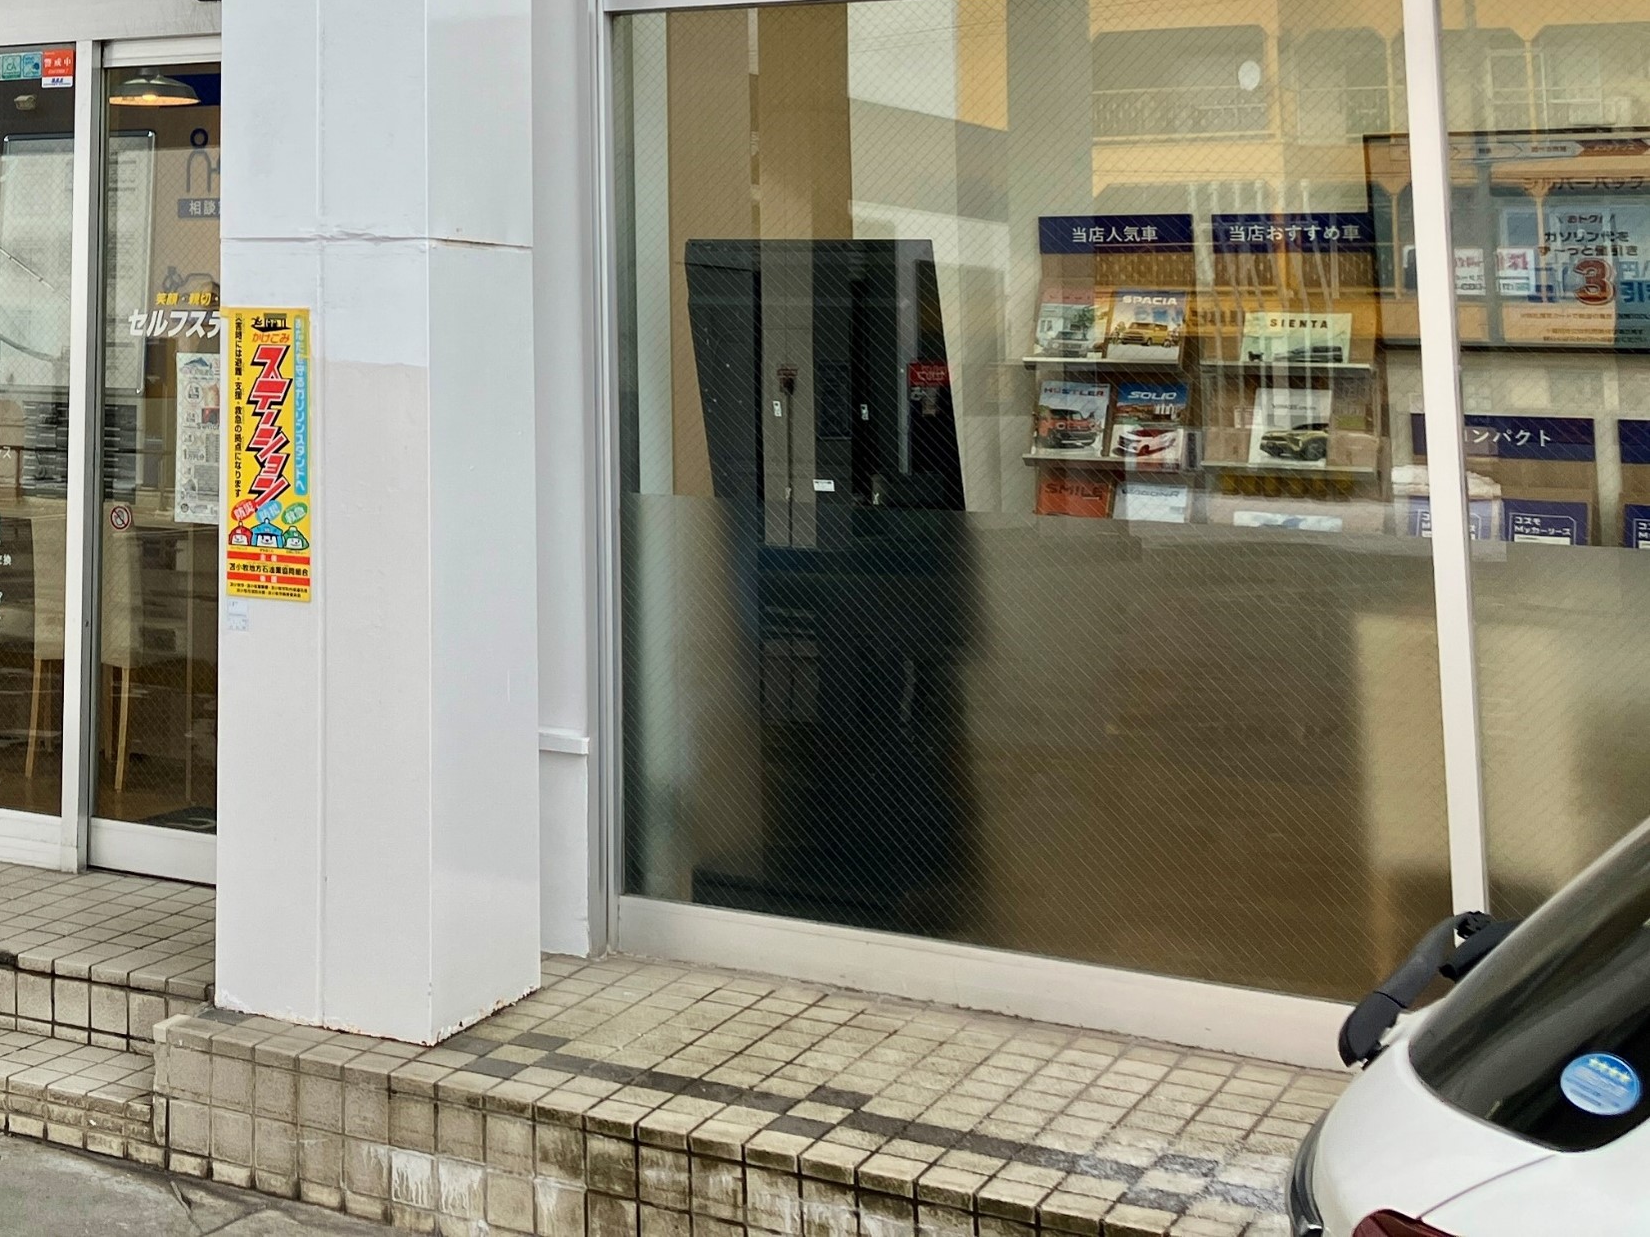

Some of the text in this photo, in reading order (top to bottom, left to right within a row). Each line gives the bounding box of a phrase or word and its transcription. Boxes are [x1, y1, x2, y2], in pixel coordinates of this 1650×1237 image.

[189, 200, 220, 215] 相談
[1072, 225, 1158, 243] 当店人気車
[1229, 224, 1361, 242] 当店おすすめ車
[1122, 295, 1177, 305] SPACIA
[1269, 318, 1329, 329] SIENTA
[252, 333, 290, 344] かけこみ
[1044, 387, 1104, 396] HUSTLER
[1127, 391, 1177, 400] SOLIO
[245, 343, 294, 512] ステーション
[1465, 429, 1552, 447] ンパクト
[1045, 483, 1103, 497] SMILE
